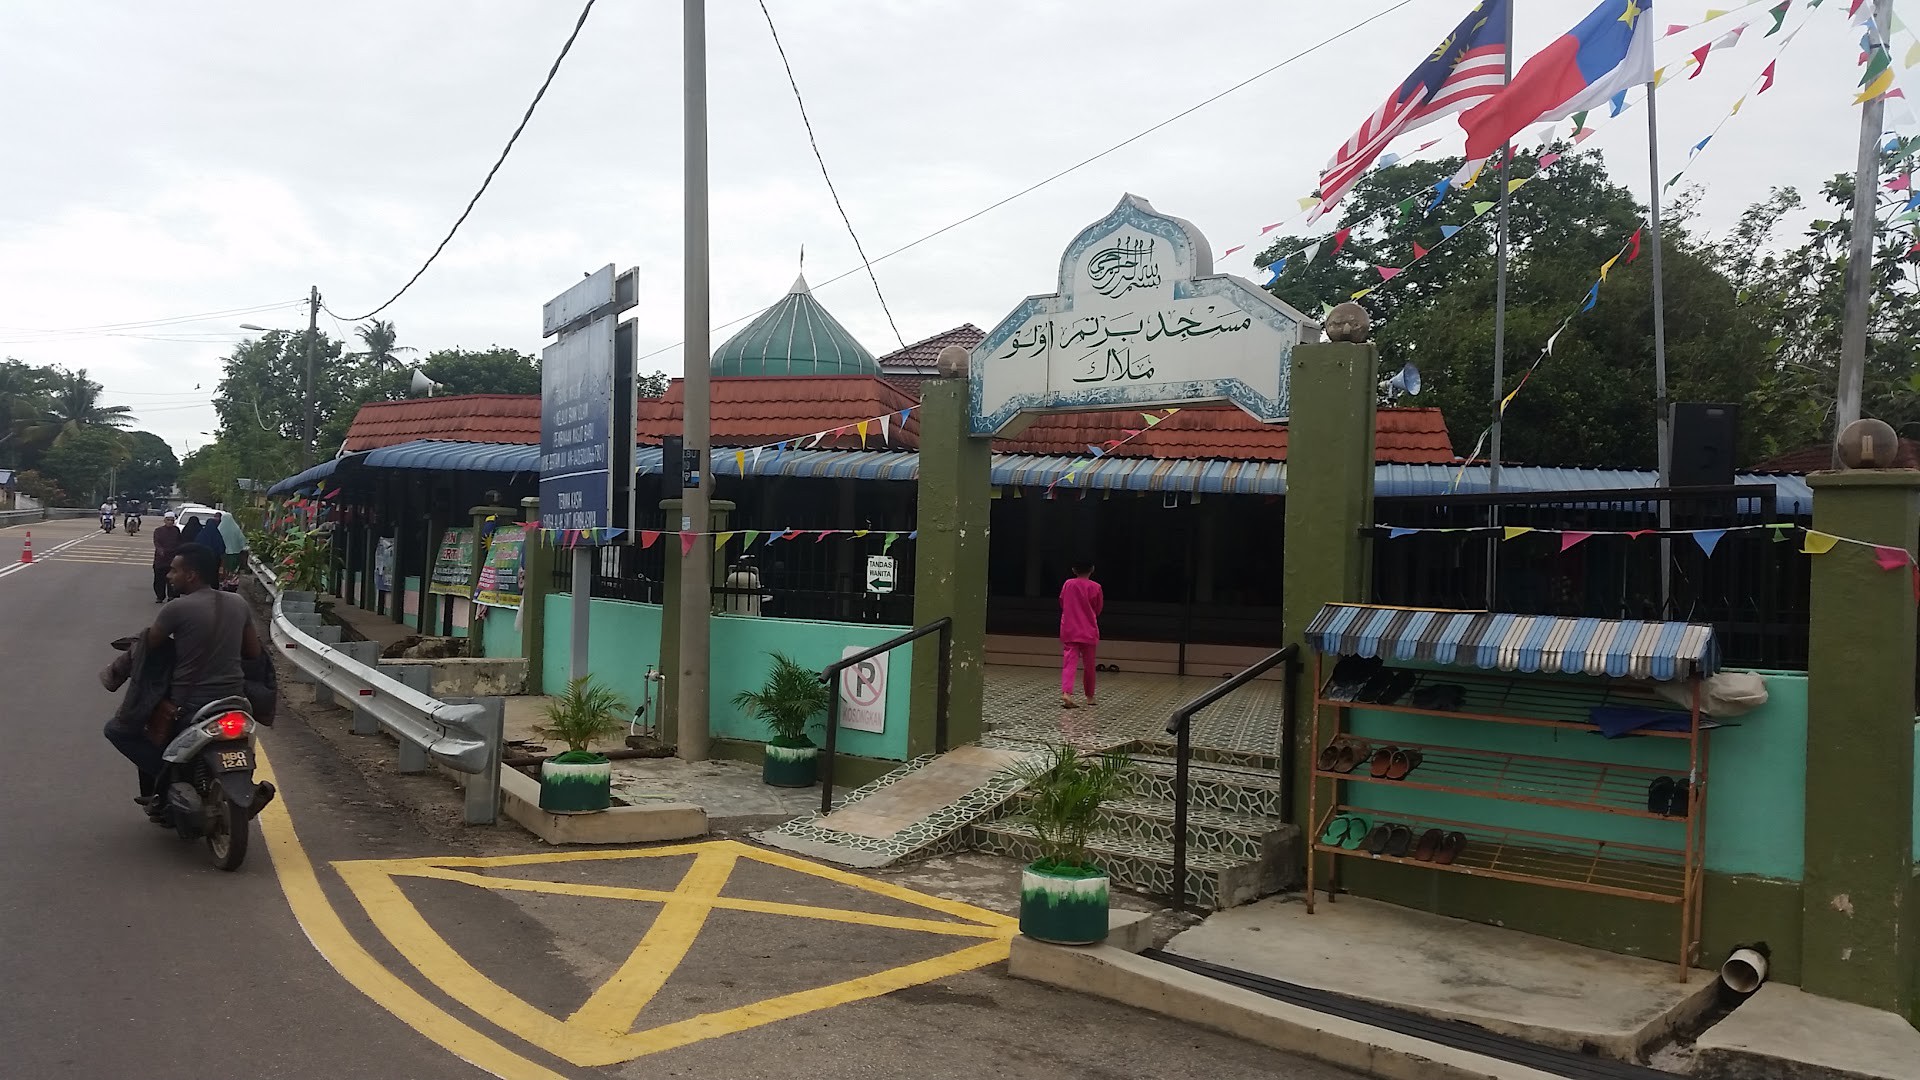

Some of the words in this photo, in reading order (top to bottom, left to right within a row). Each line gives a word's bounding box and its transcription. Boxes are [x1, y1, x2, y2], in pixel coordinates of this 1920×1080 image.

[857, 661, 875, 697] P
[843, 707, 882, 726] KOSONGKAN
[222, 759, 247, 768] 1241
